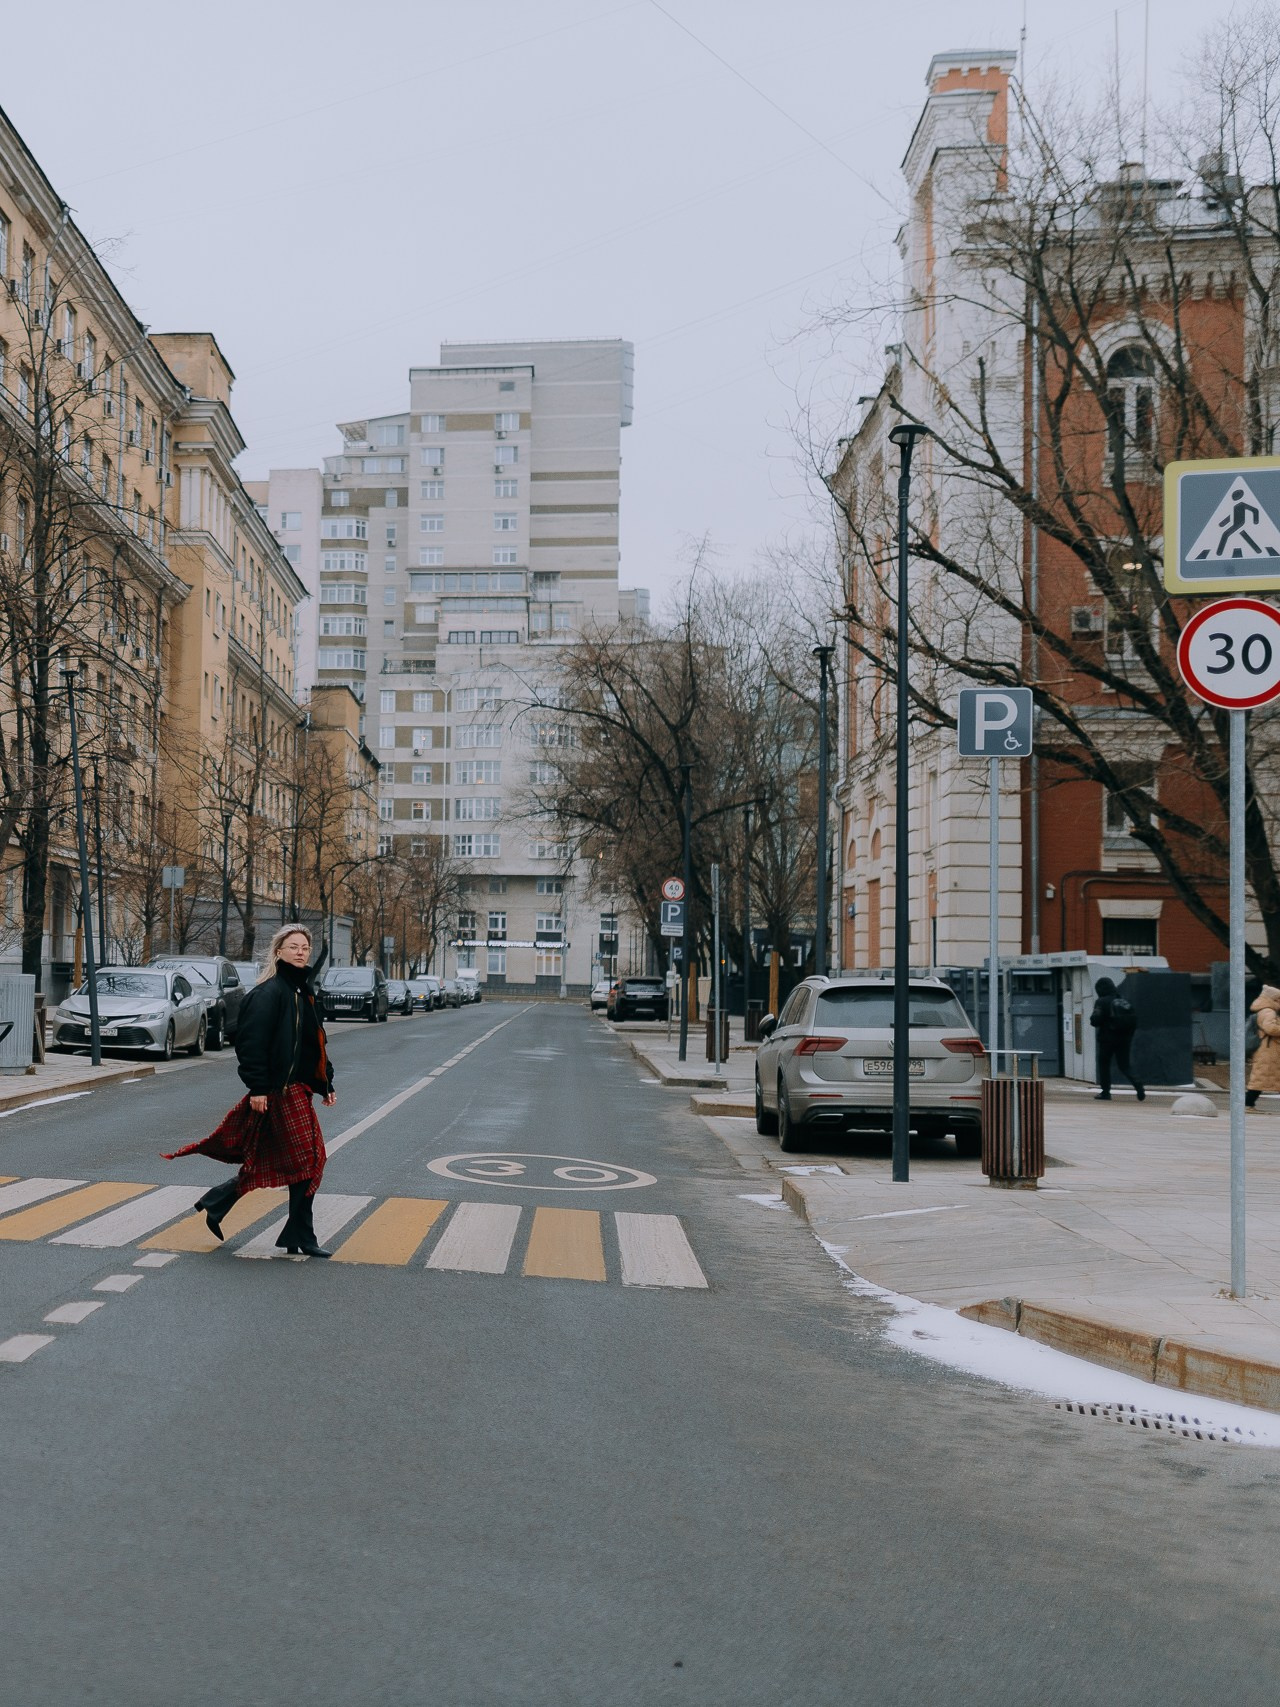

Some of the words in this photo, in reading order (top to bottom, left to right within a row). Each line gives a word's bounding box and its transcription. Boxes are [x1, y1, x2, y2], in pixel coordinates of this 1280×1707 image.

[1206, 632, 1273, 676] 30
[974, 693, 1018, 750] P
[667, 904, 680, 922] P
[465, 1160, 619, 1183] 30
